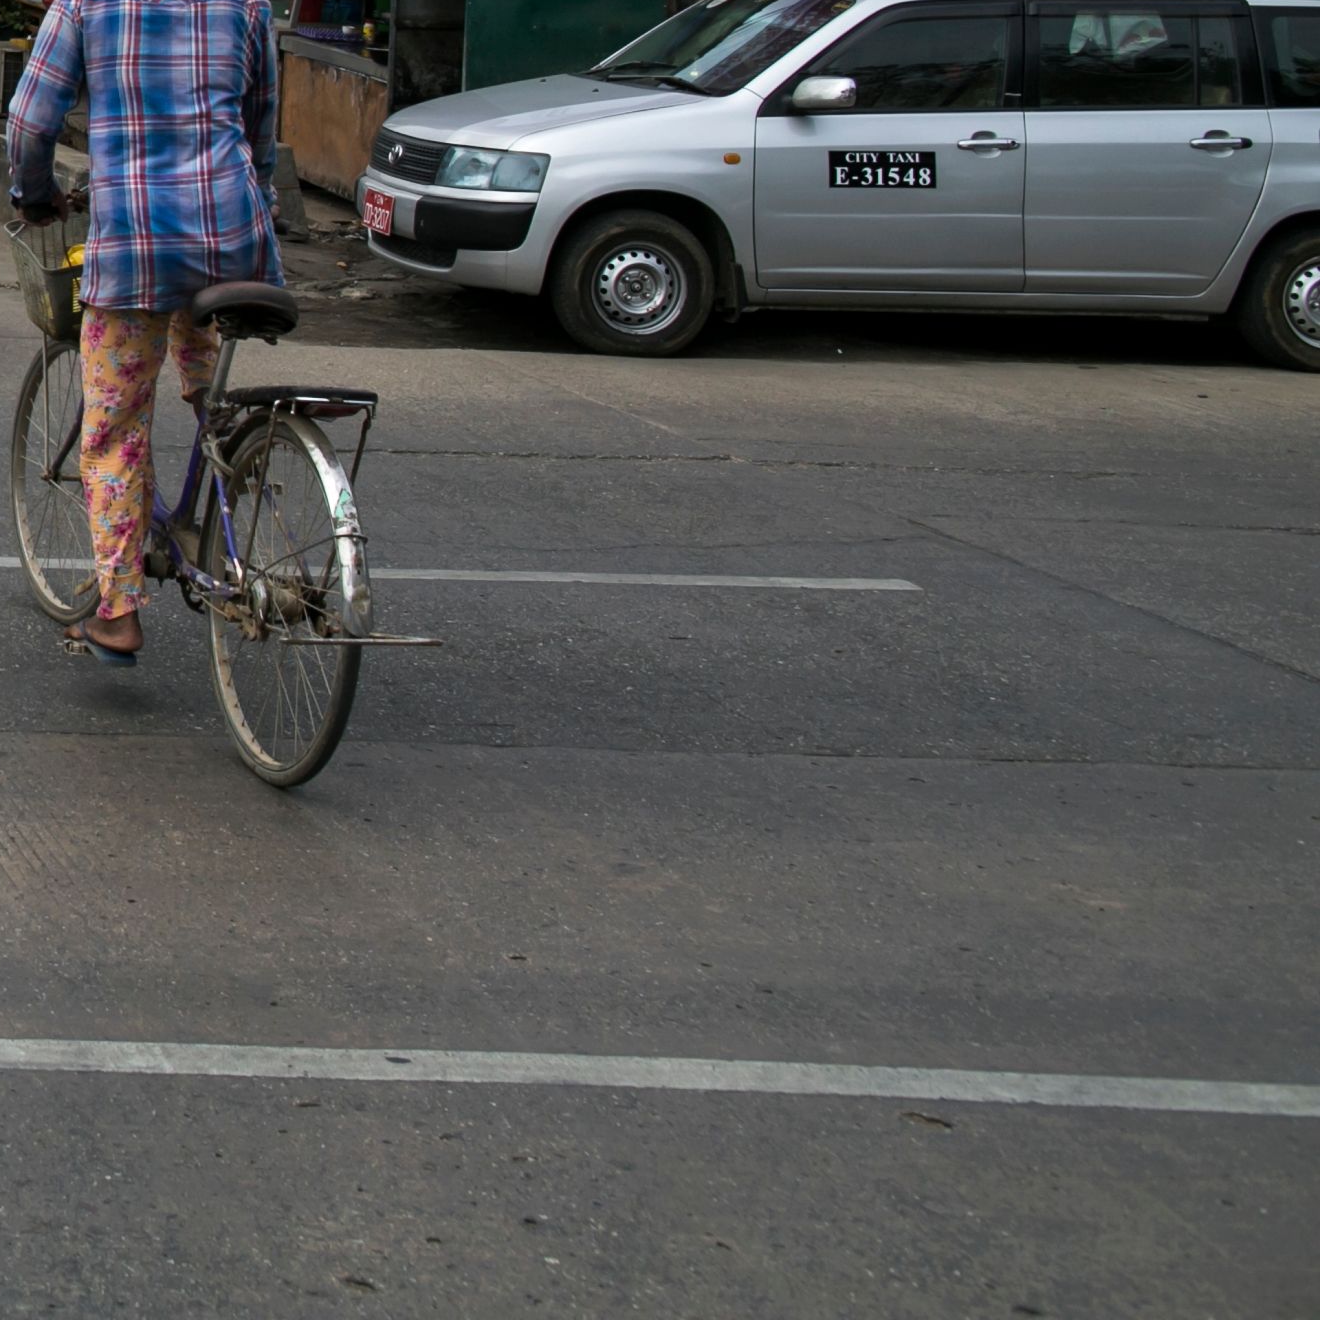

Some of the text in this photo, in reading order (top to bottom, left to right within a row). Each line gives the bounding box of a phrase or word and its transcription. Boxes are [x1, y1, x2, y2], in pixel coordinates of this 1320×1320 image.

[845, 152, 920, 163] CITY TAXI
[834, 166, 931, 186] E-31548
